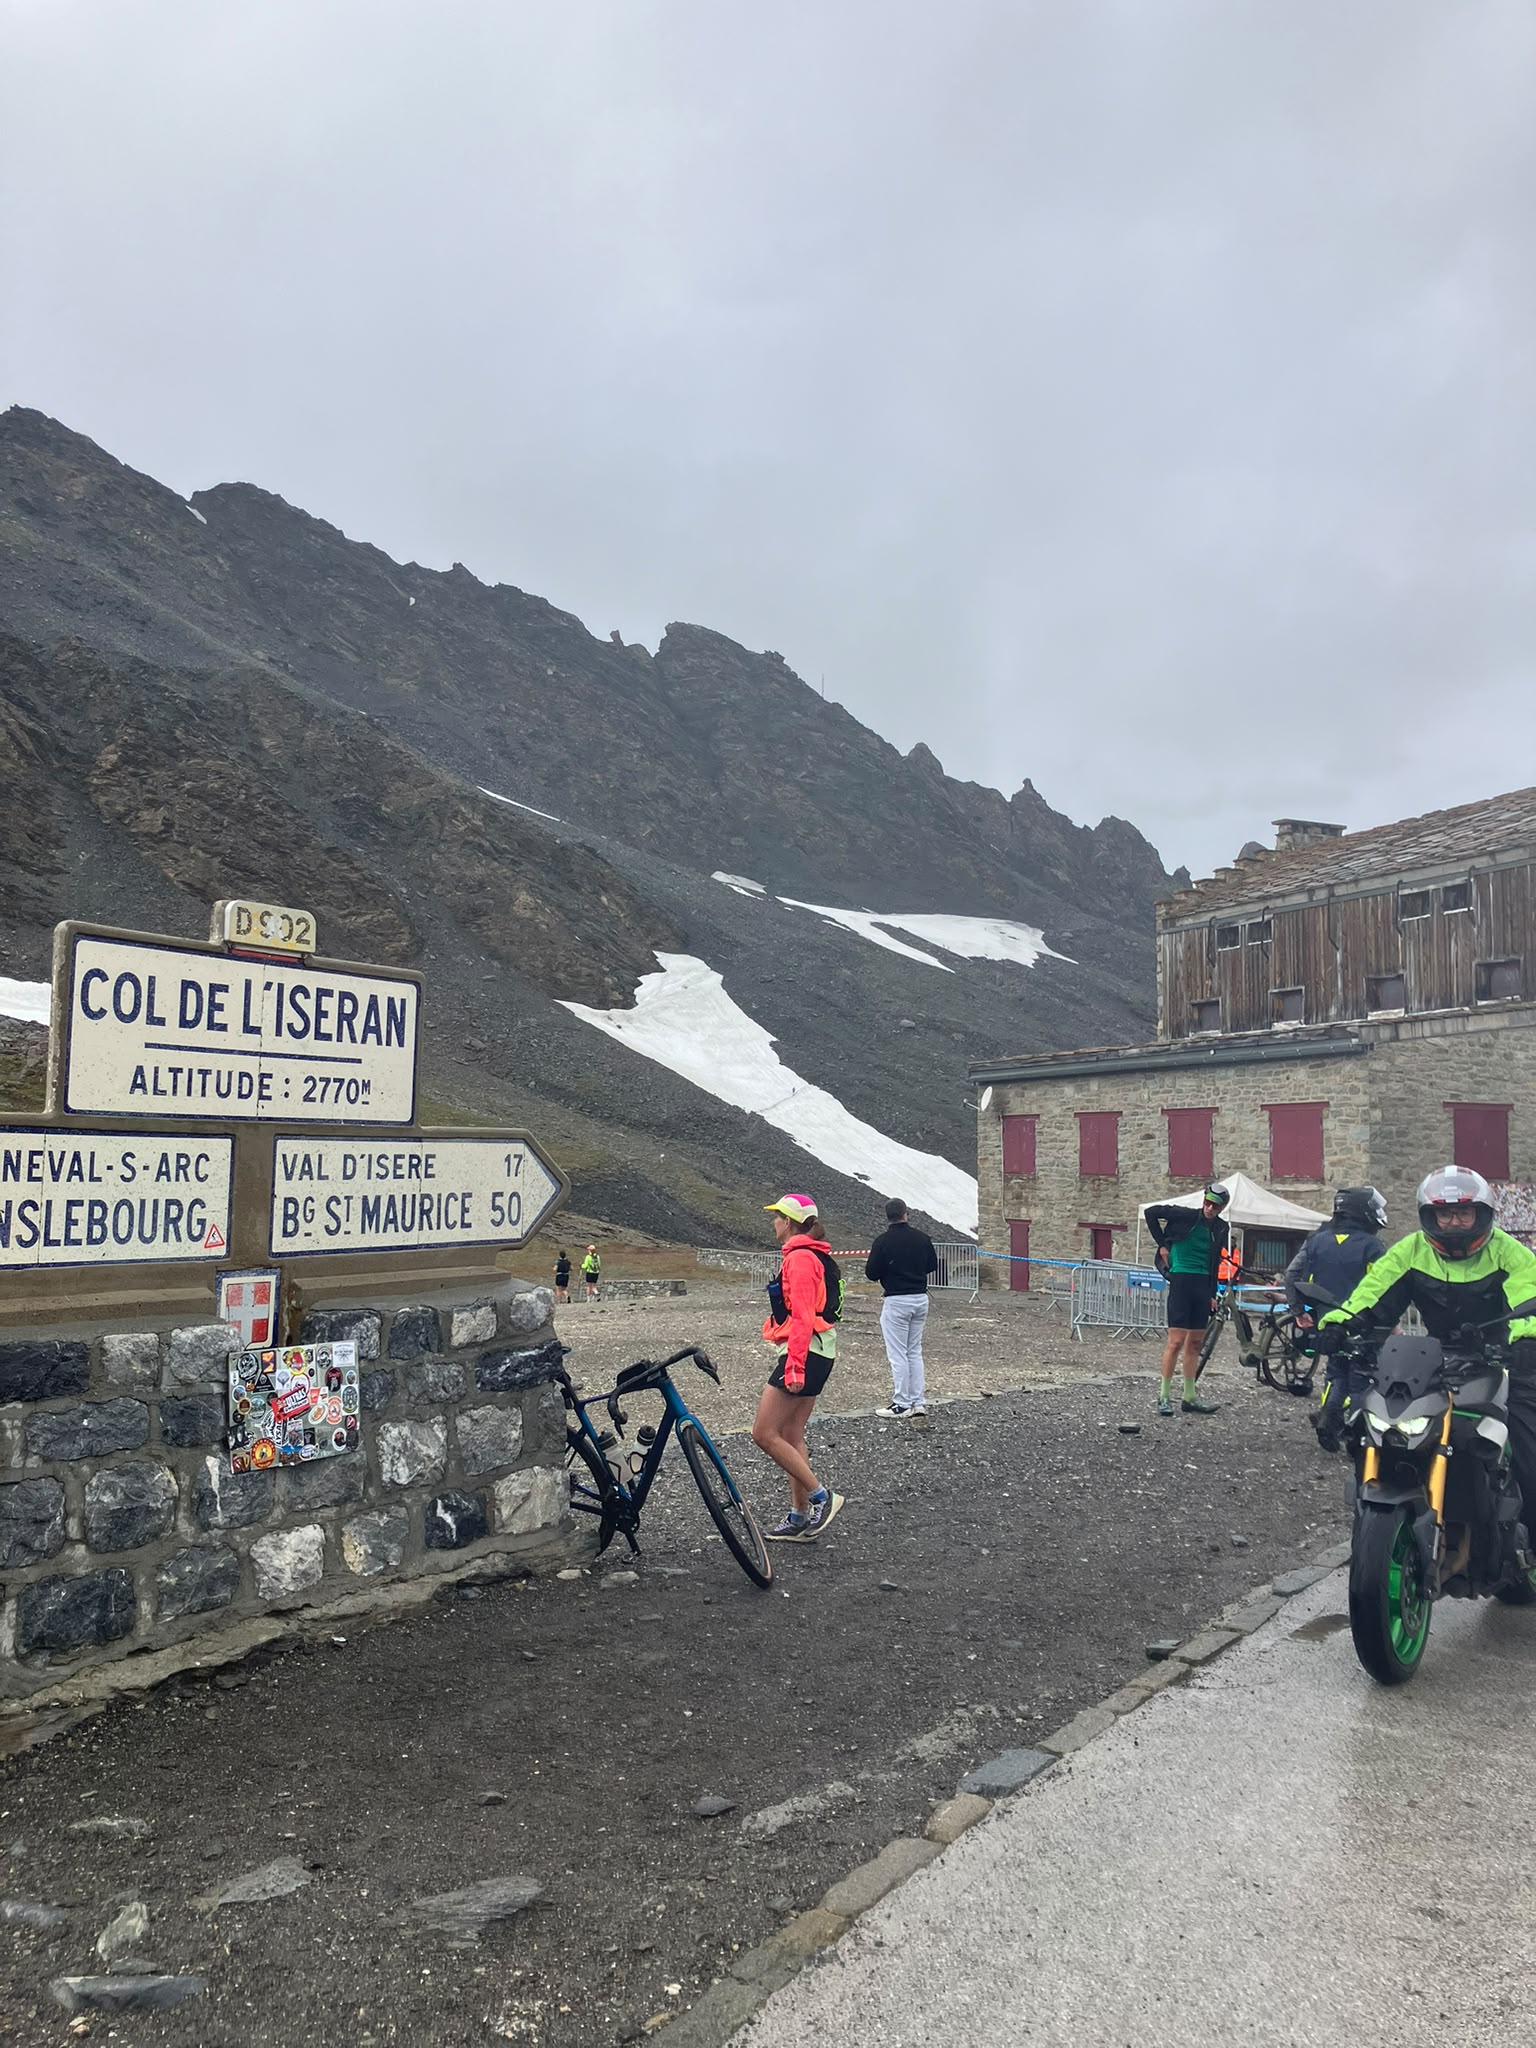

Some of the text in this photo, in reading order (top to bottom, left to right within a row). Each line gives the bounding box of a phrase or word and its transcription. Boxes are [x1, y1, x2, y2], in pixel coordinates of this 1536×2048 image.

[80, 967, 407, 1048] COL DE L'ISERAN
[129, 1064, 274, 1101] ALTITUDE
[281, 1153, 523, 1181] VAL D'ISERE 17
[360, 1191, 473, 1235] MAURICE
[490, 1190, 522, 1228] 50
